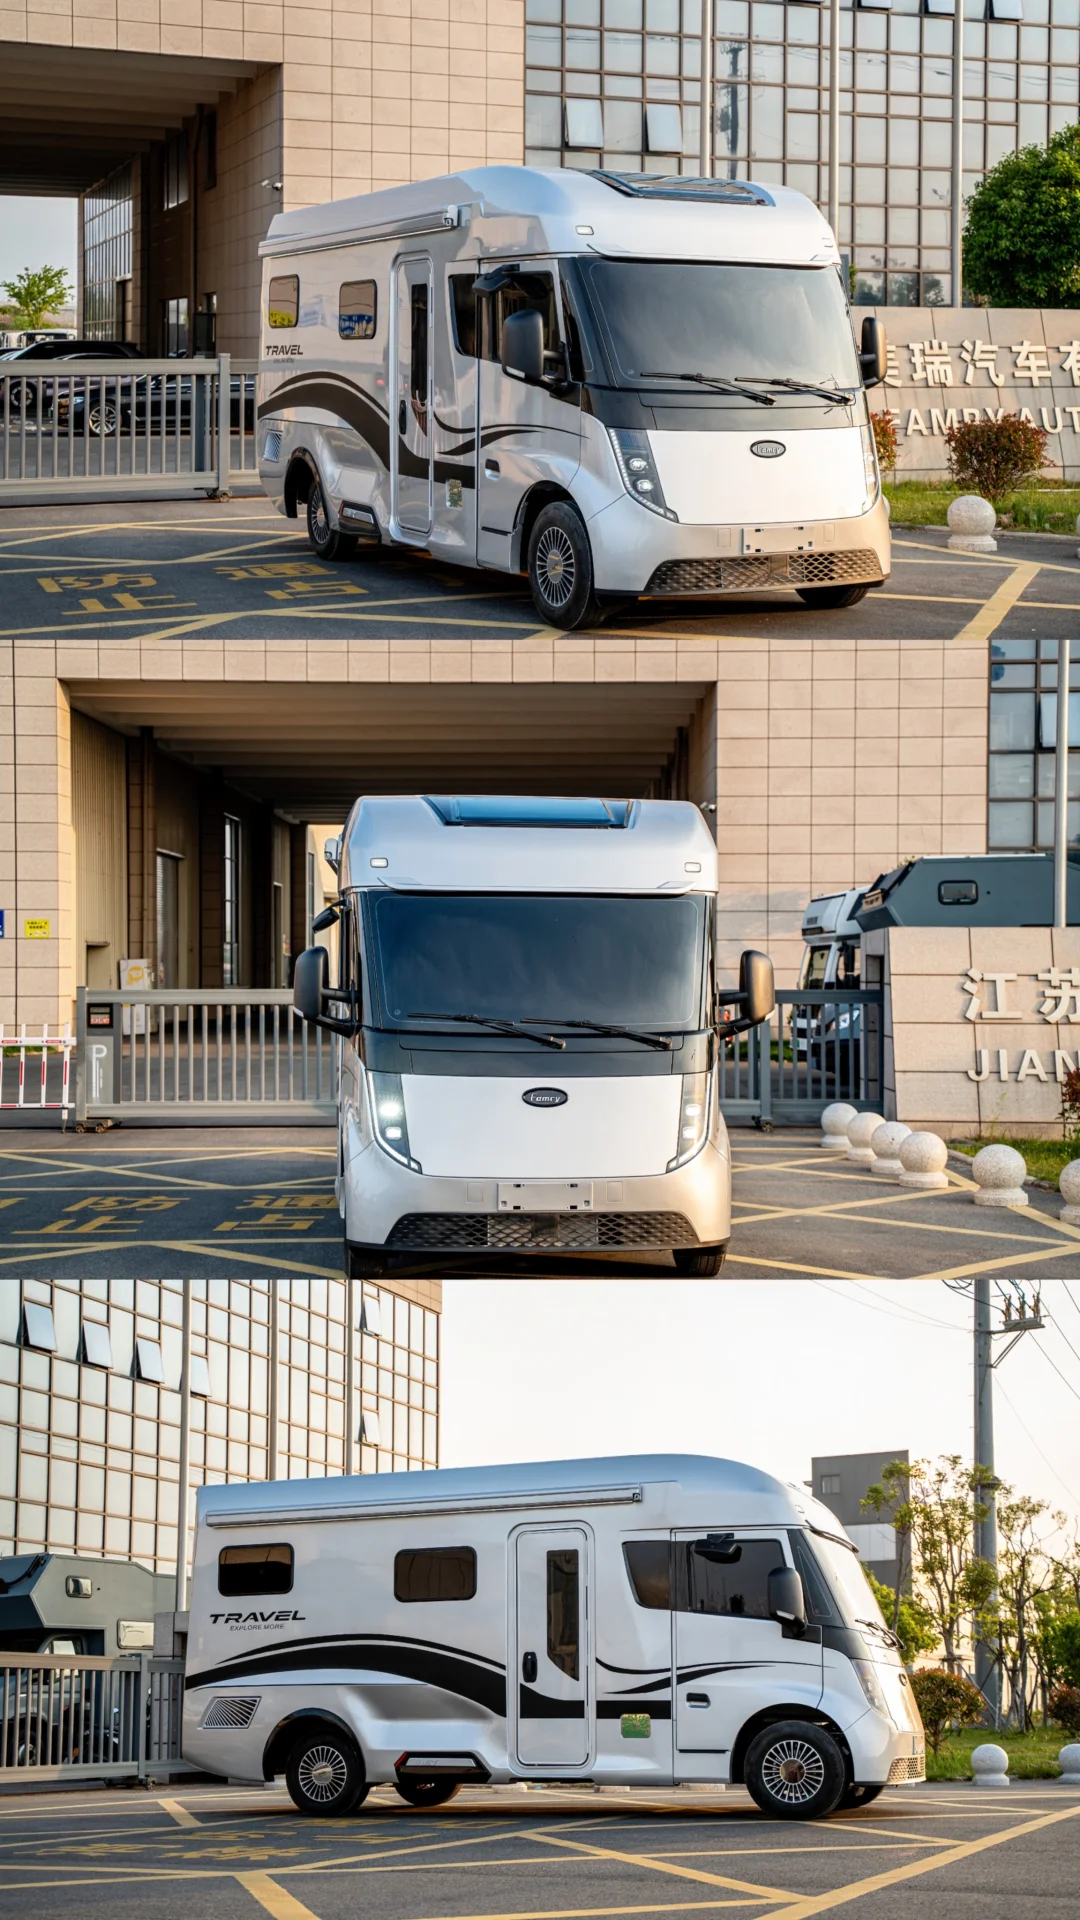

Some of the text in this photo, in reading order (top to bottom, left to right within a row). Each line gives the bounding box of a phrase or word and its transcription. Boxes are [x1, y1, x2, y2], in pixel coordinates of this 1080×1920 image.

[265, 344, 304, 356] TRAVEL
[961, 967, 1080, 1024] 江苏
[967, 1048, 1080, 1082] JIAN
[209, 1610, 306, 1624] TRAVEL
